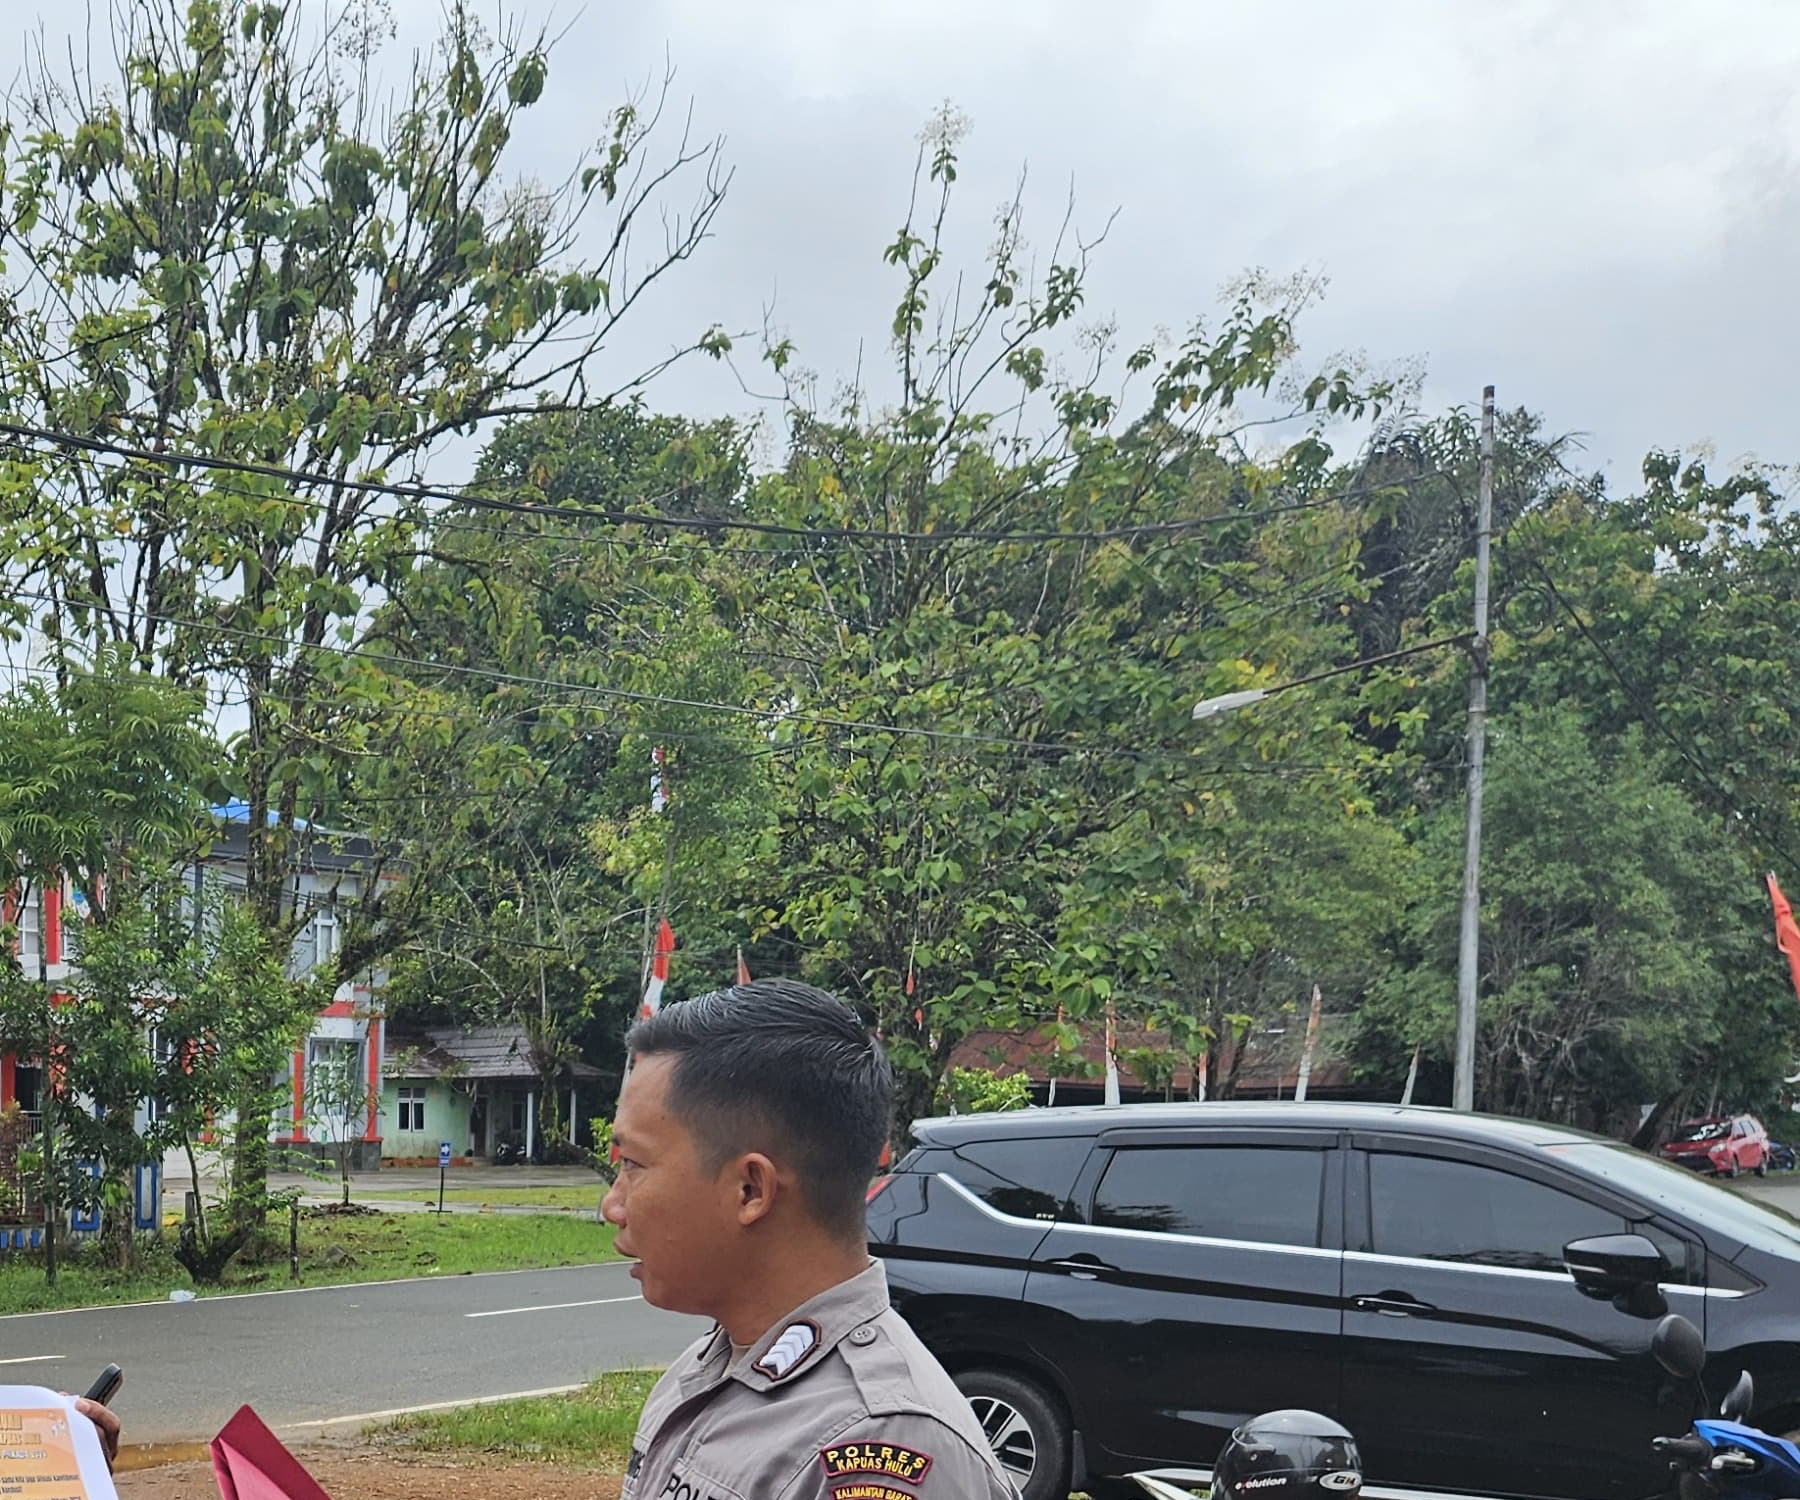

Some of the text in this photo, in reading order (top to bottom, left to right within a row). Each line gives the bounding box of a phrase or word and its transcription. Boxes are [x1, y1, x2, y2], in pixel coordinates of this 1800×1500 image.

[826, 1444, 926, 1470] POLRES
[836, 1456, 913, 1478] KAPUAS HULU
[1235, 1477, 1287, 1491] evolution
